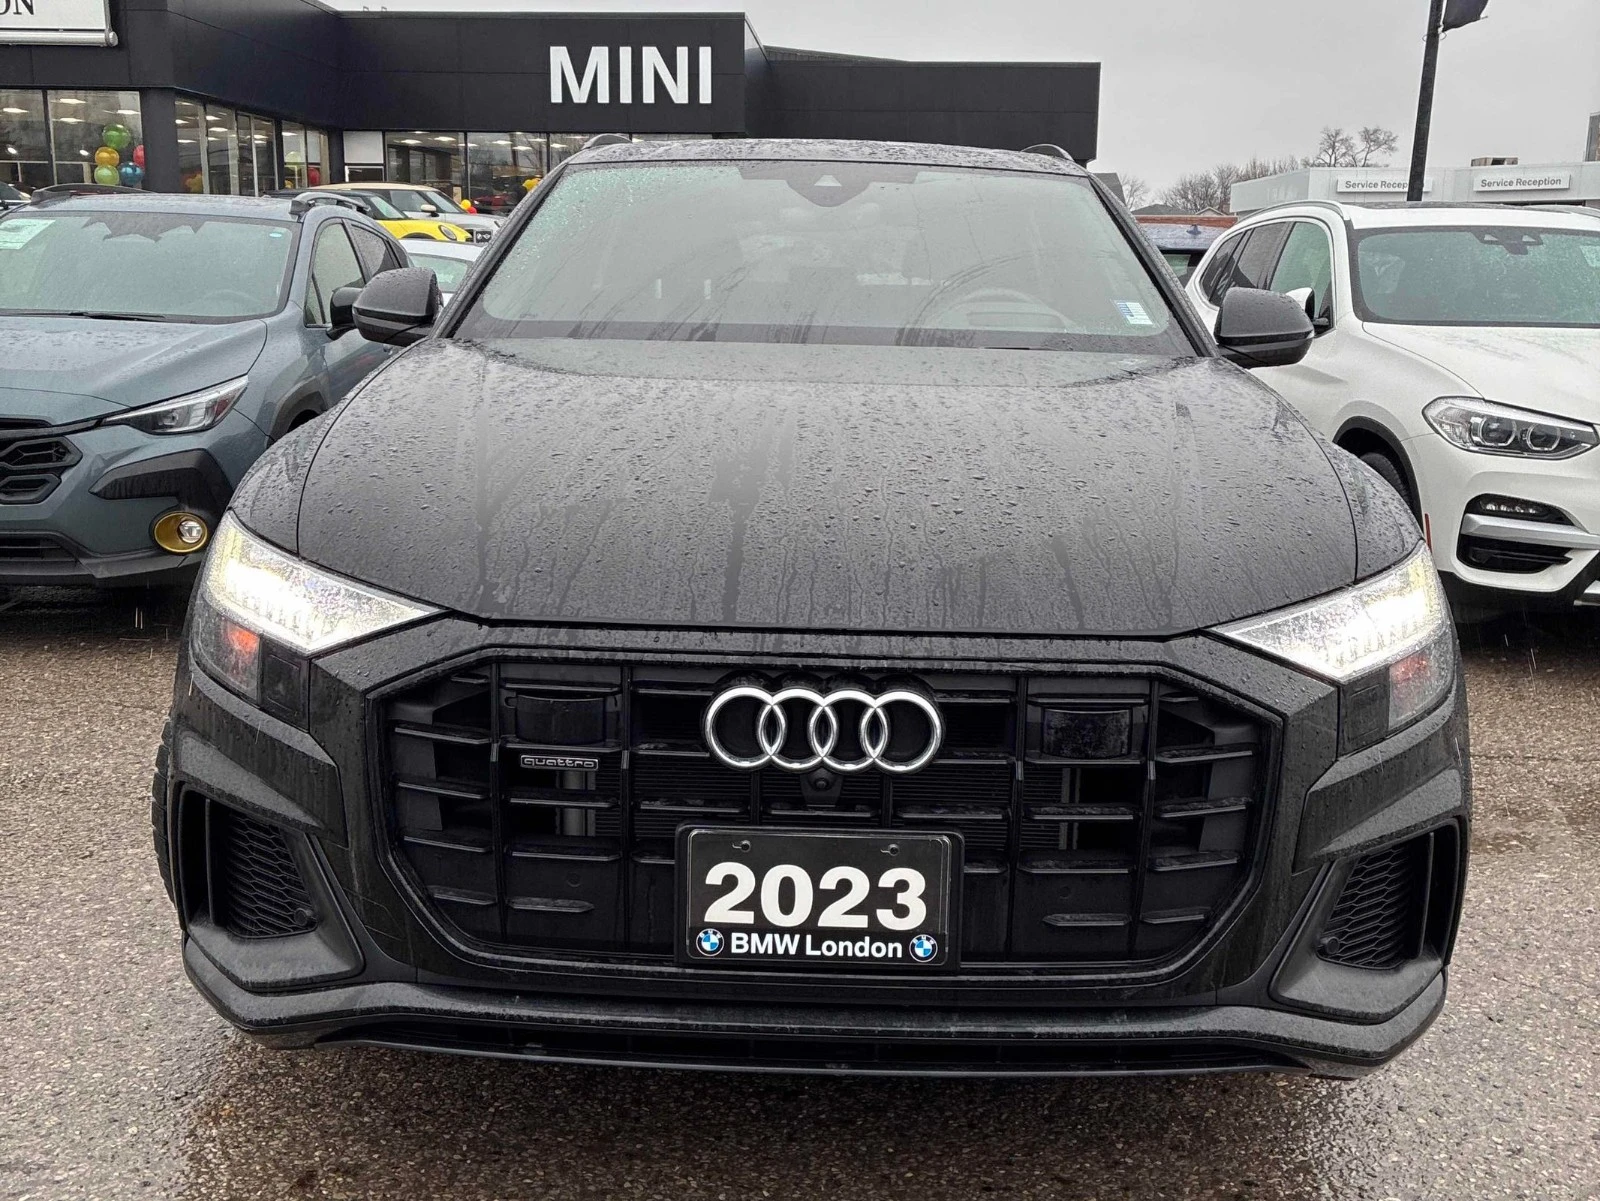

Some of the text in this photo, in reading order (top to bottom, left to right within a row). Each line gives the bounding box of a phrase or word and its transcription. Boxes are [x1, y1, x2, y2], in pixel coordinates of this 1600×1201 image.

[549, 46, 712, 104] MINI
[1345, 180, 1409, 190] Service Recep
[1480, 176, 1562, 188] Service Reception
[524, 758, 594, 767] quattro
[704, 861, 927, 930] 2023
[730, 932, 902, 958] BMW London
